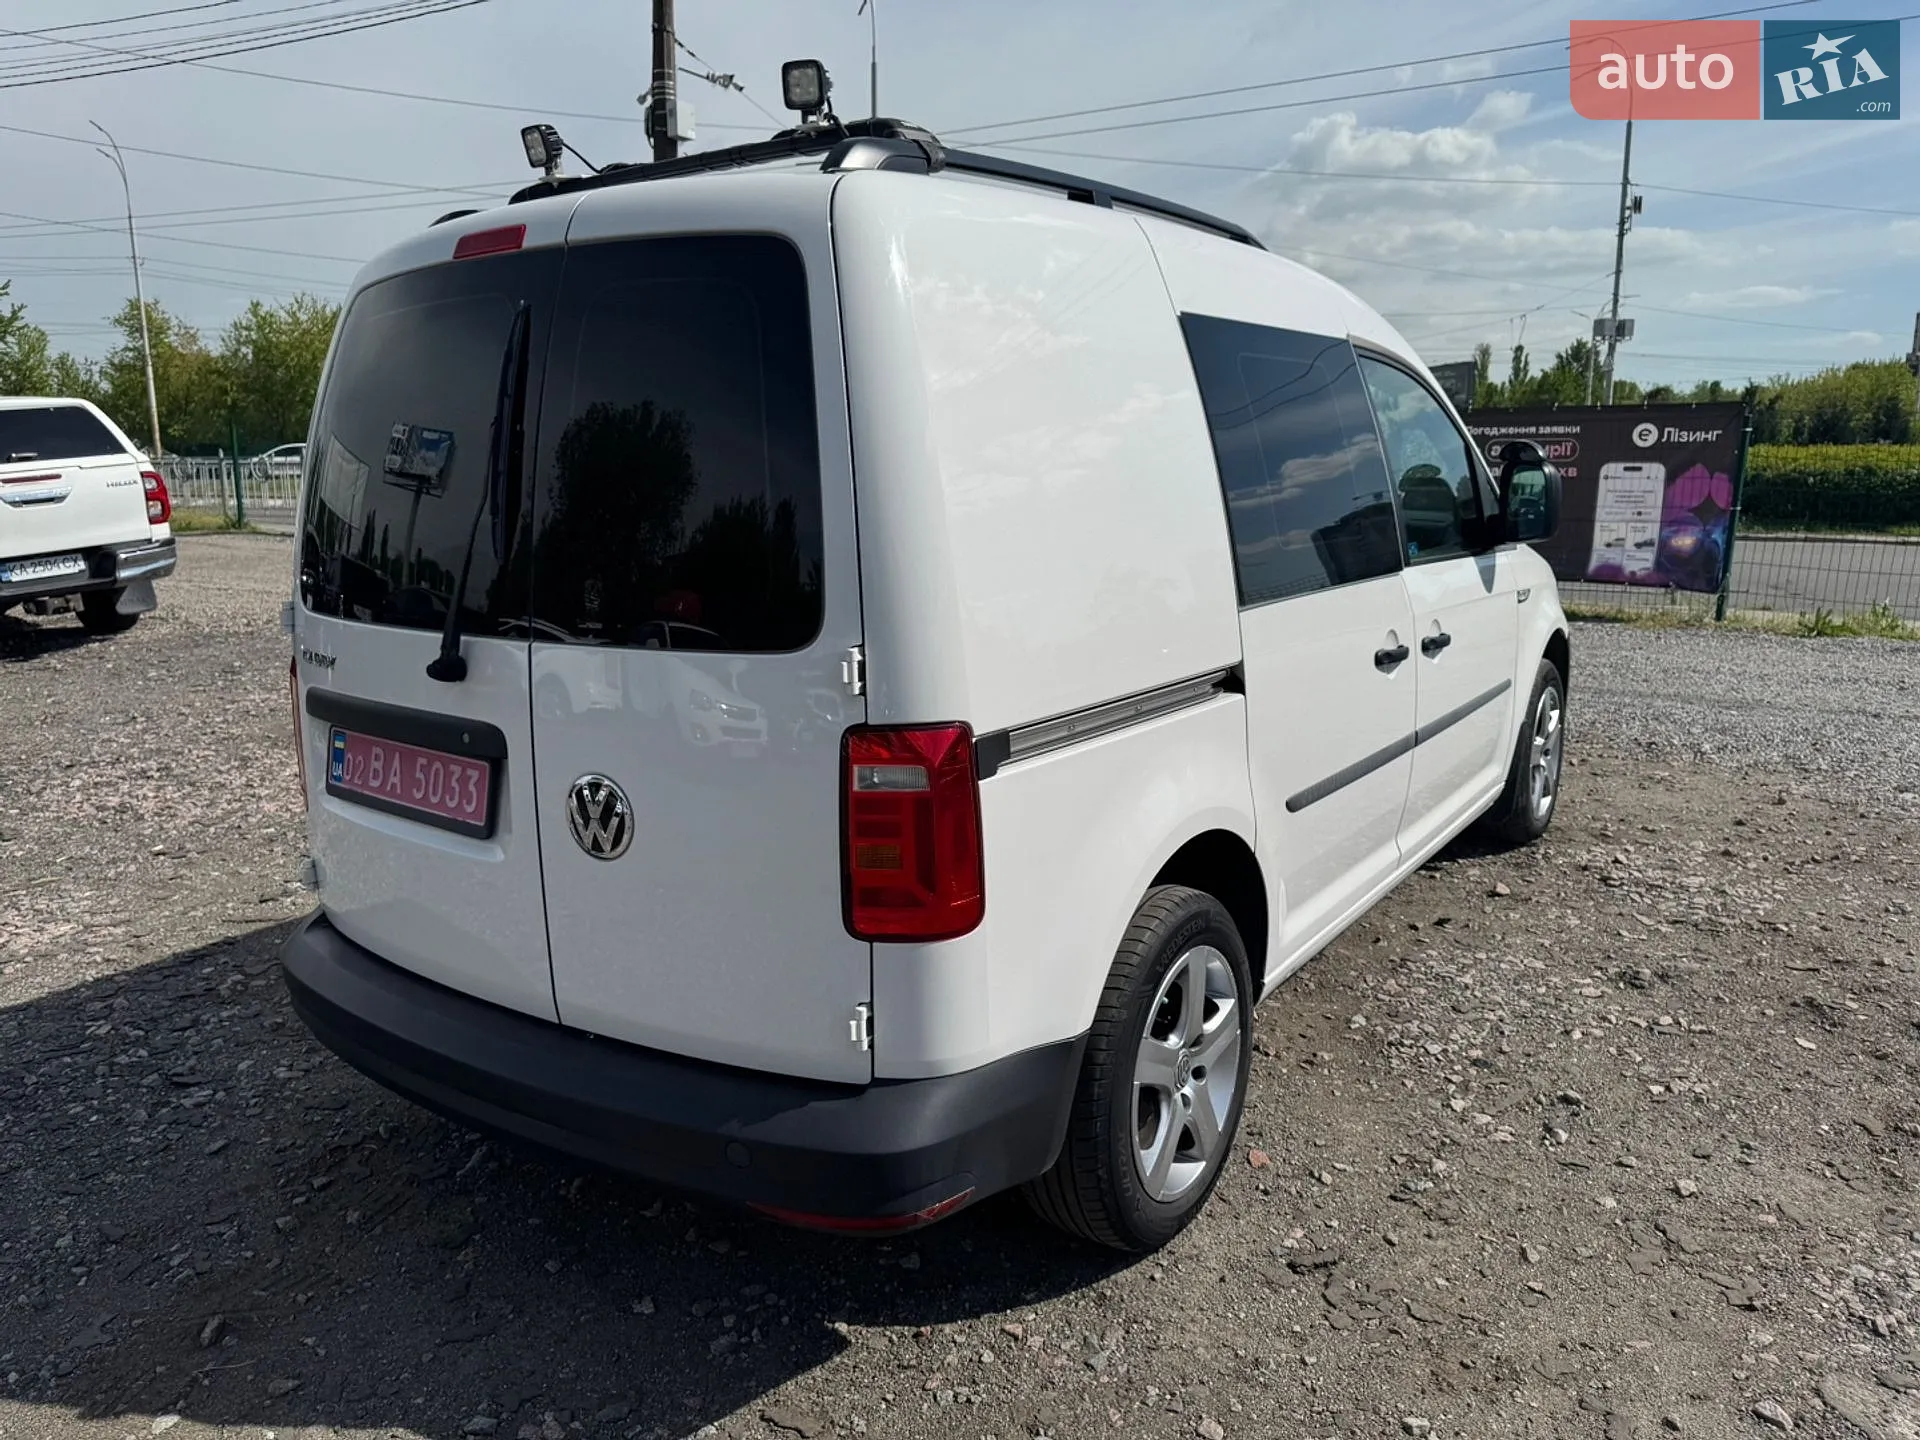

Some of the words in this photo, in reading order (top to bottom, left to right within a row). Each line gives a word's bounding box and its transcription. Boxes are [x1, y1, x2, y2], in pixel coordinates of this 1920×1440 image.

[1661, 427, 1723, 442] Лізинг
[331, 761, 343, 777] UA
[412, 756, 480, 814] 5033
